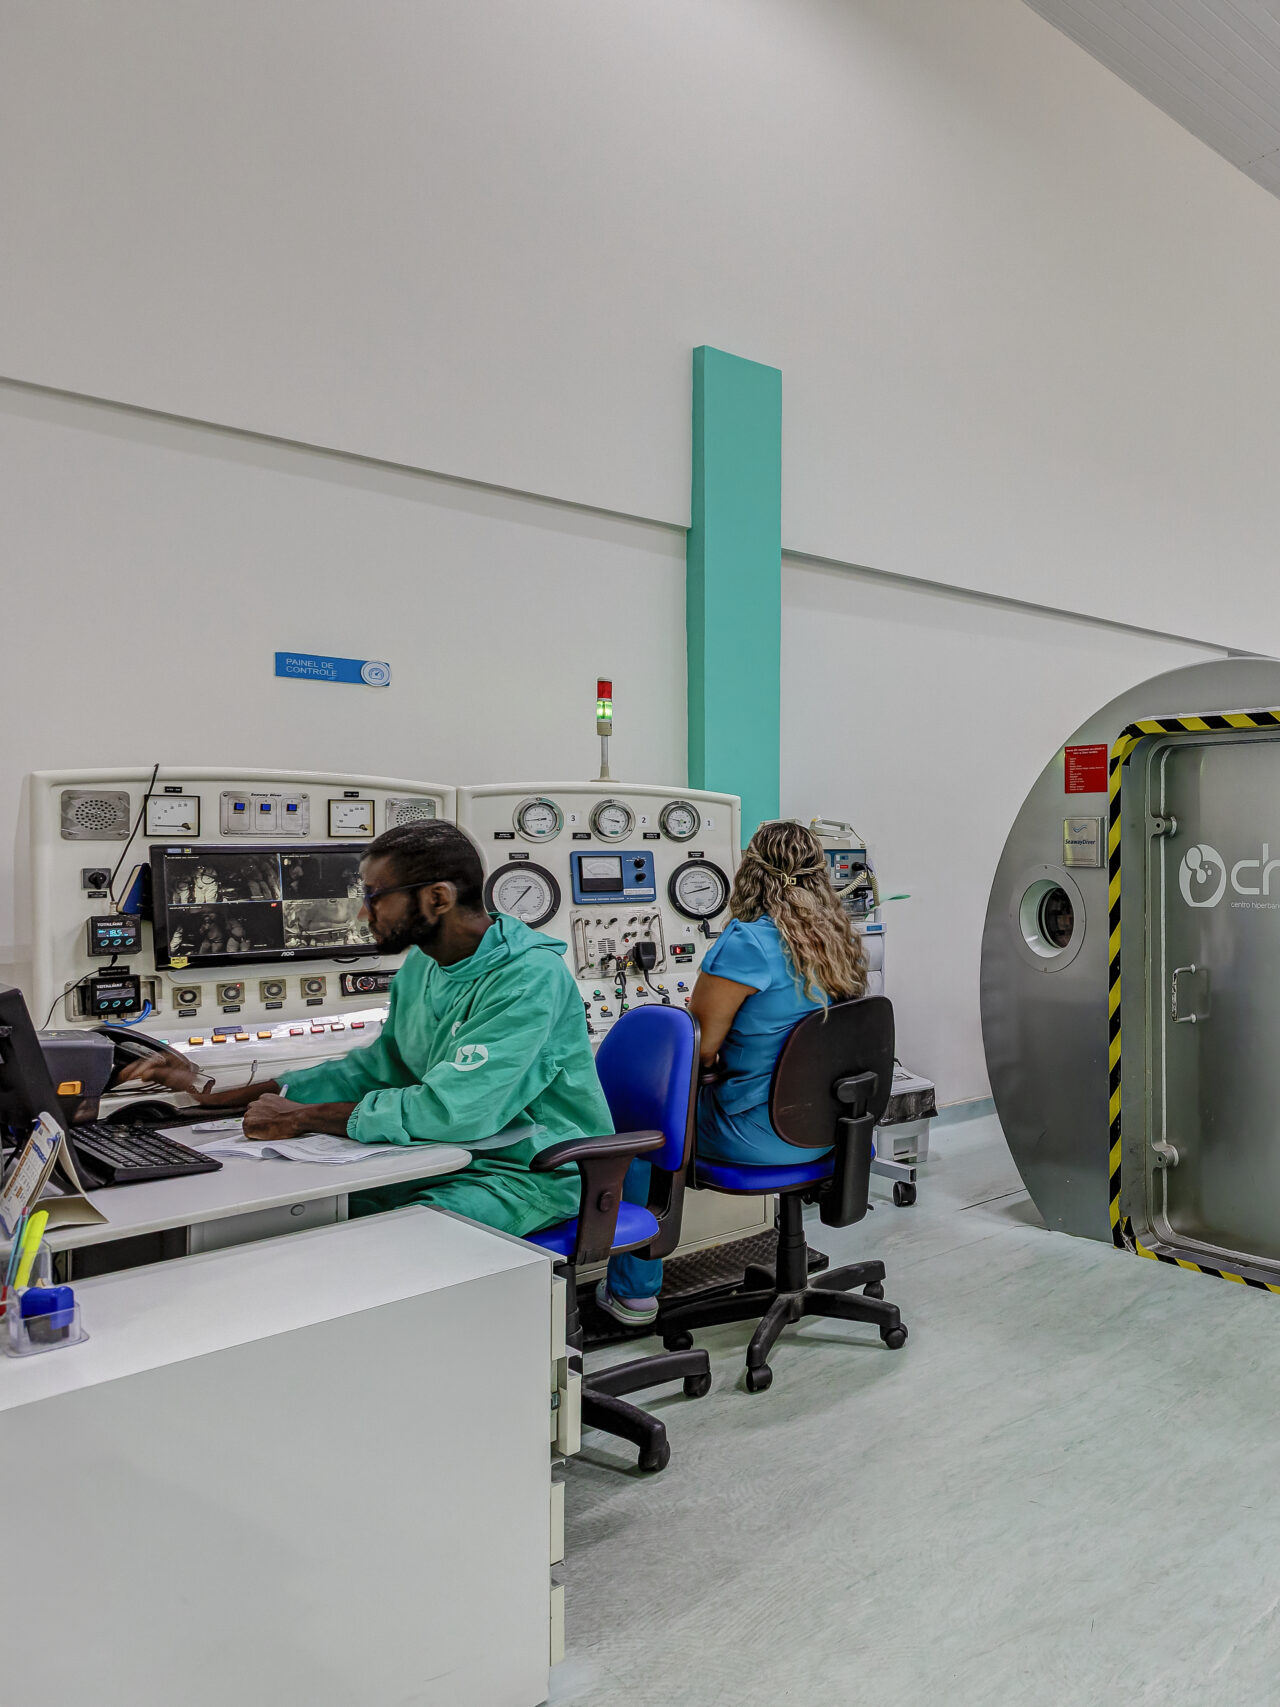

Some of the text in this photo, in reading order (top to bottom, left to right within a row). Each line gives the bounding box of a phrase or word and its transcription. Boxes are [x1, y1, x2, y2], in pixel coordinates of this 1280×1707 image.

[285, 658, 334, 669] PAINEL DE
[285, 665, 337, 677] CONTROLE
[571, 814, 576, 822] 3
